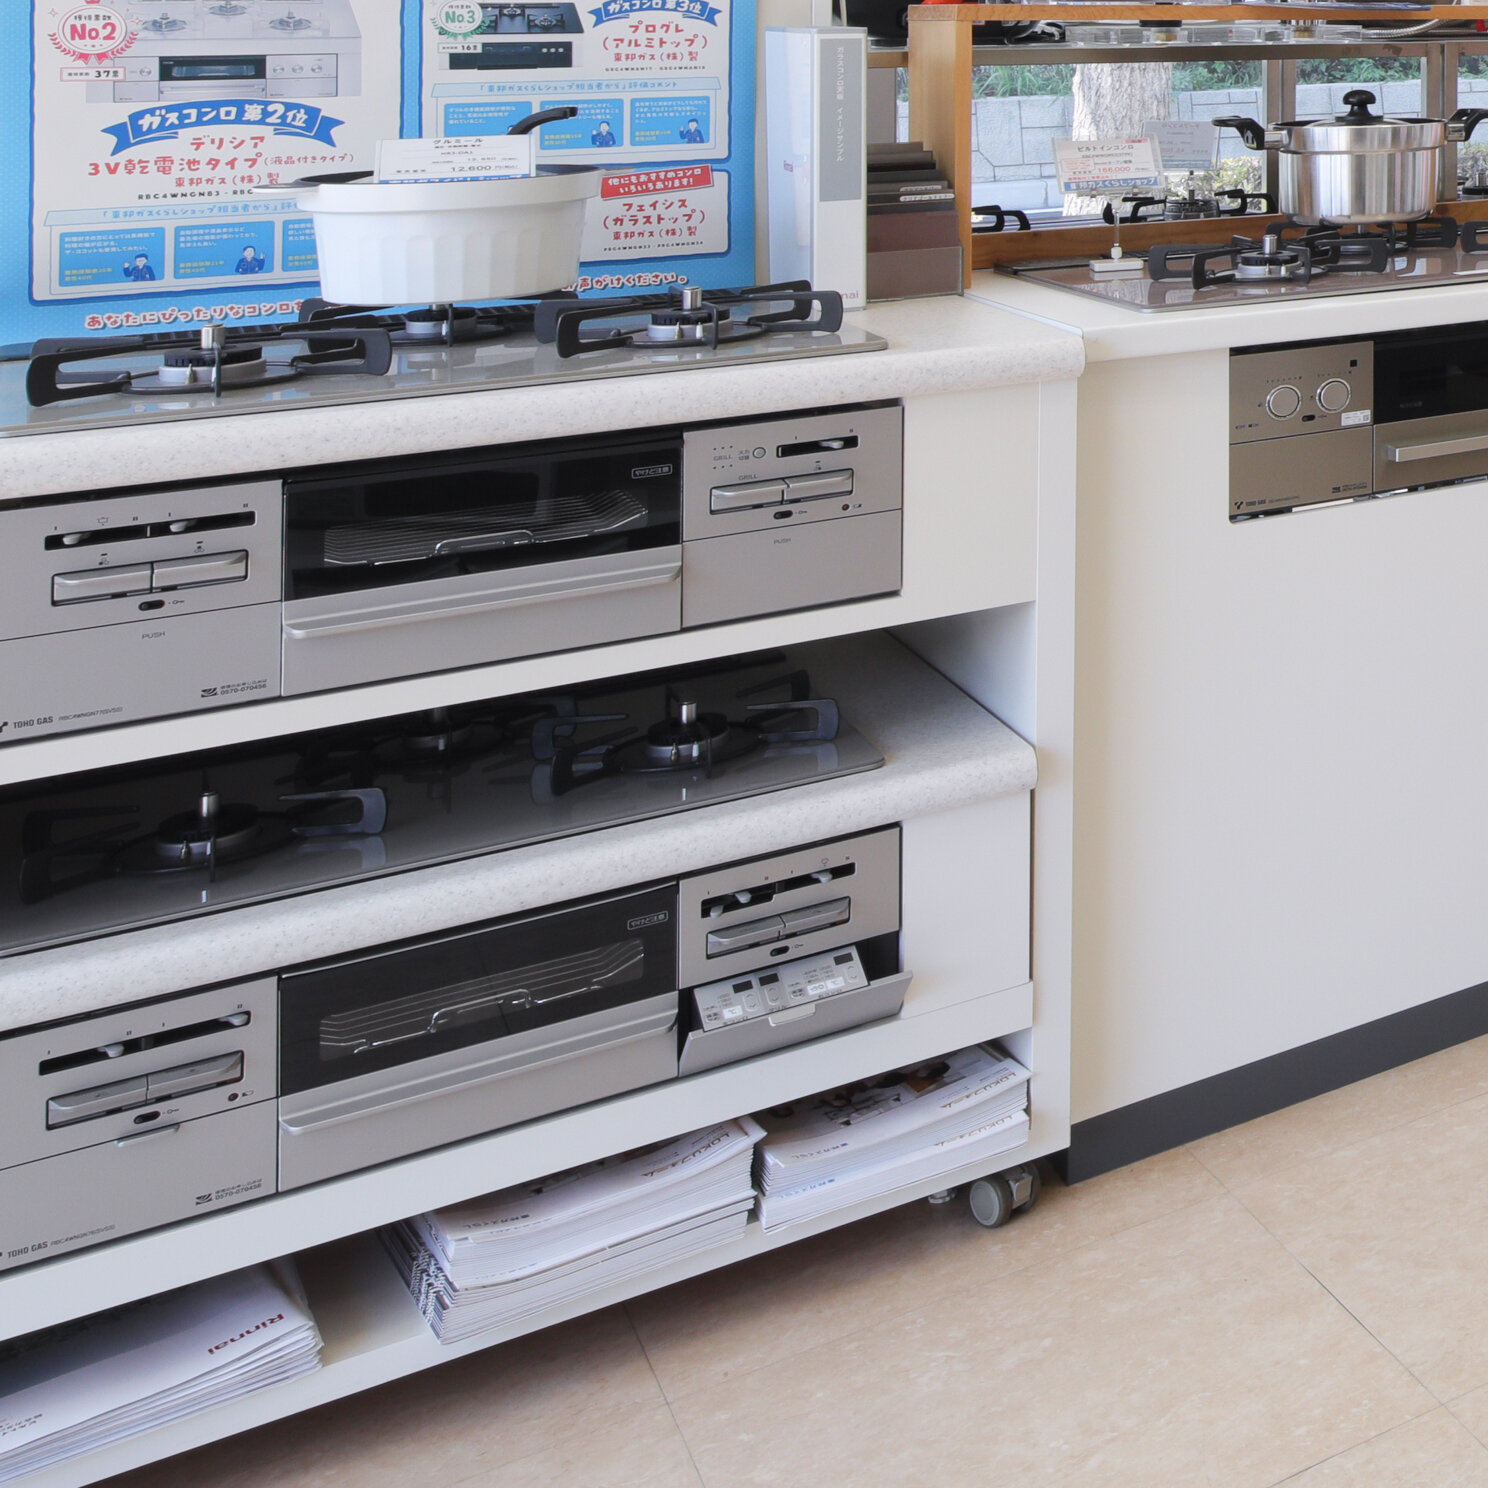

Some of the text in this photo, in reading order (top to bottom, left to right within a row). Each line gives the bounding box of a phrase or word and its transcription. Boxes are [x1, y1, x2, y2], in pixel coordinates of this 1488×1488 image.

[445, 10, 476, 25] No.3
[70, 22, 117, 42] No.2
[628, 21, 685, 35] プログレ
[137, 102, 309, 132] ガスコンロ 第2位
[190, 134, 265, 151] デリシア
[88, 152, 263, 176] 3V乾電池タイプ
[175, 172, 280, 188] 東邦ガス（株）製
[607, 168, 702, 187] 他にもおすすめコンロ
[622, 199, 688, 212] フェイシス
[141, 631, 166, 640] PUSH
[13, 715, 54, 729] TOHO GAS
[7, 1241, 49, 1259] TOHO GAS
[207, 1313, 285, 1355] Rinnai
